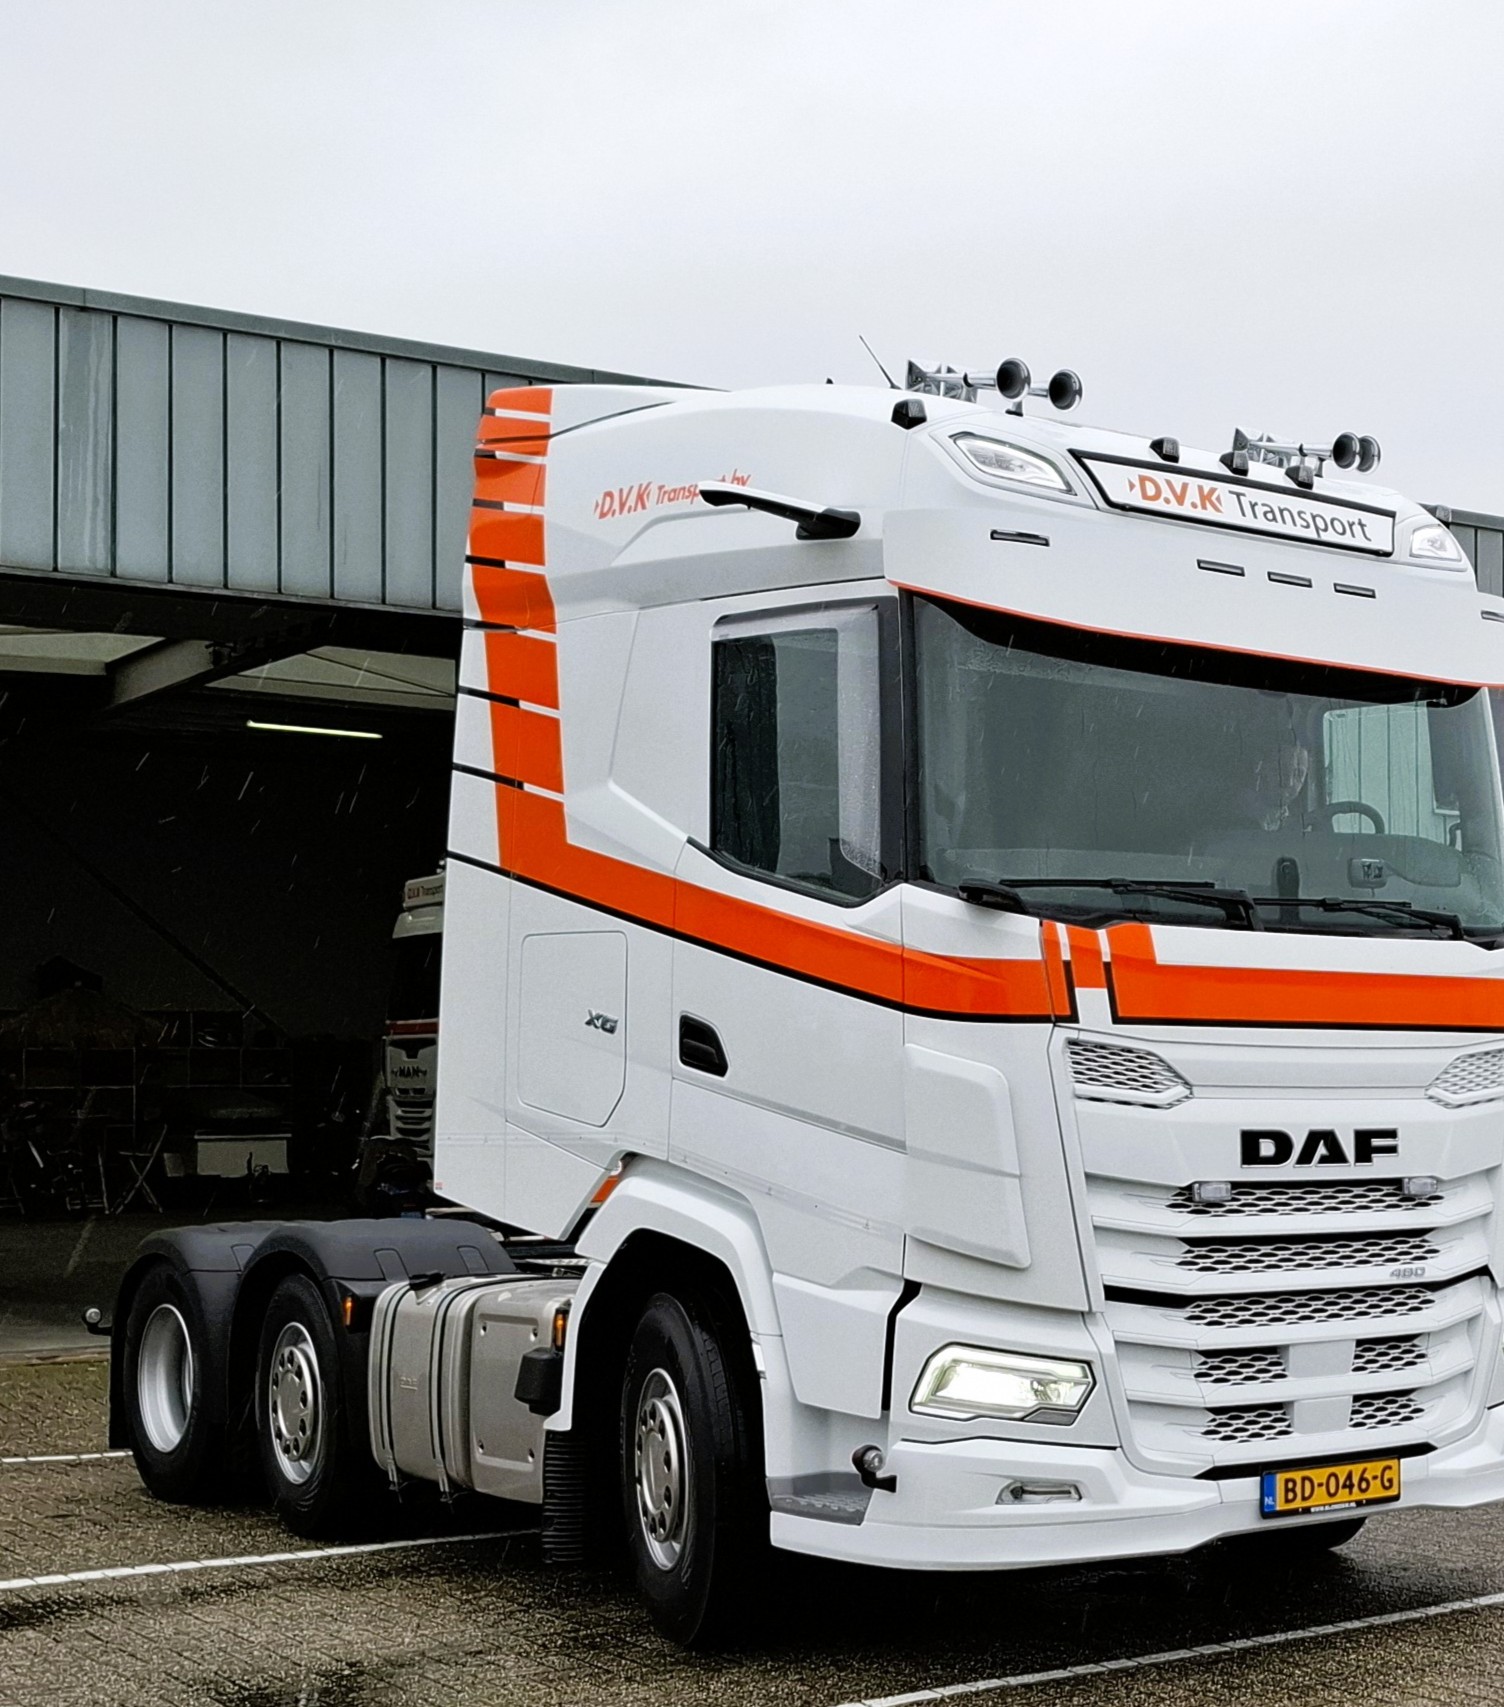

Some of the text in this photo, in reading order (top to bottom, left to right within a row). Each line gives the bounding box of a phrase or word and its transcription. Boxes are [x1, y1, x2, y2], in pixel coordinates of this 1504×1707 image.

[599, 481, 651, 520] D.V.K
[1138, 474, 1372, 542] D.V.K Transport
[1240, 1129, 1399, 1168] DAF
[1264, 1496, 1275, 1506] NL
[1284, 1465, 1394, 1504] BD-046-G
